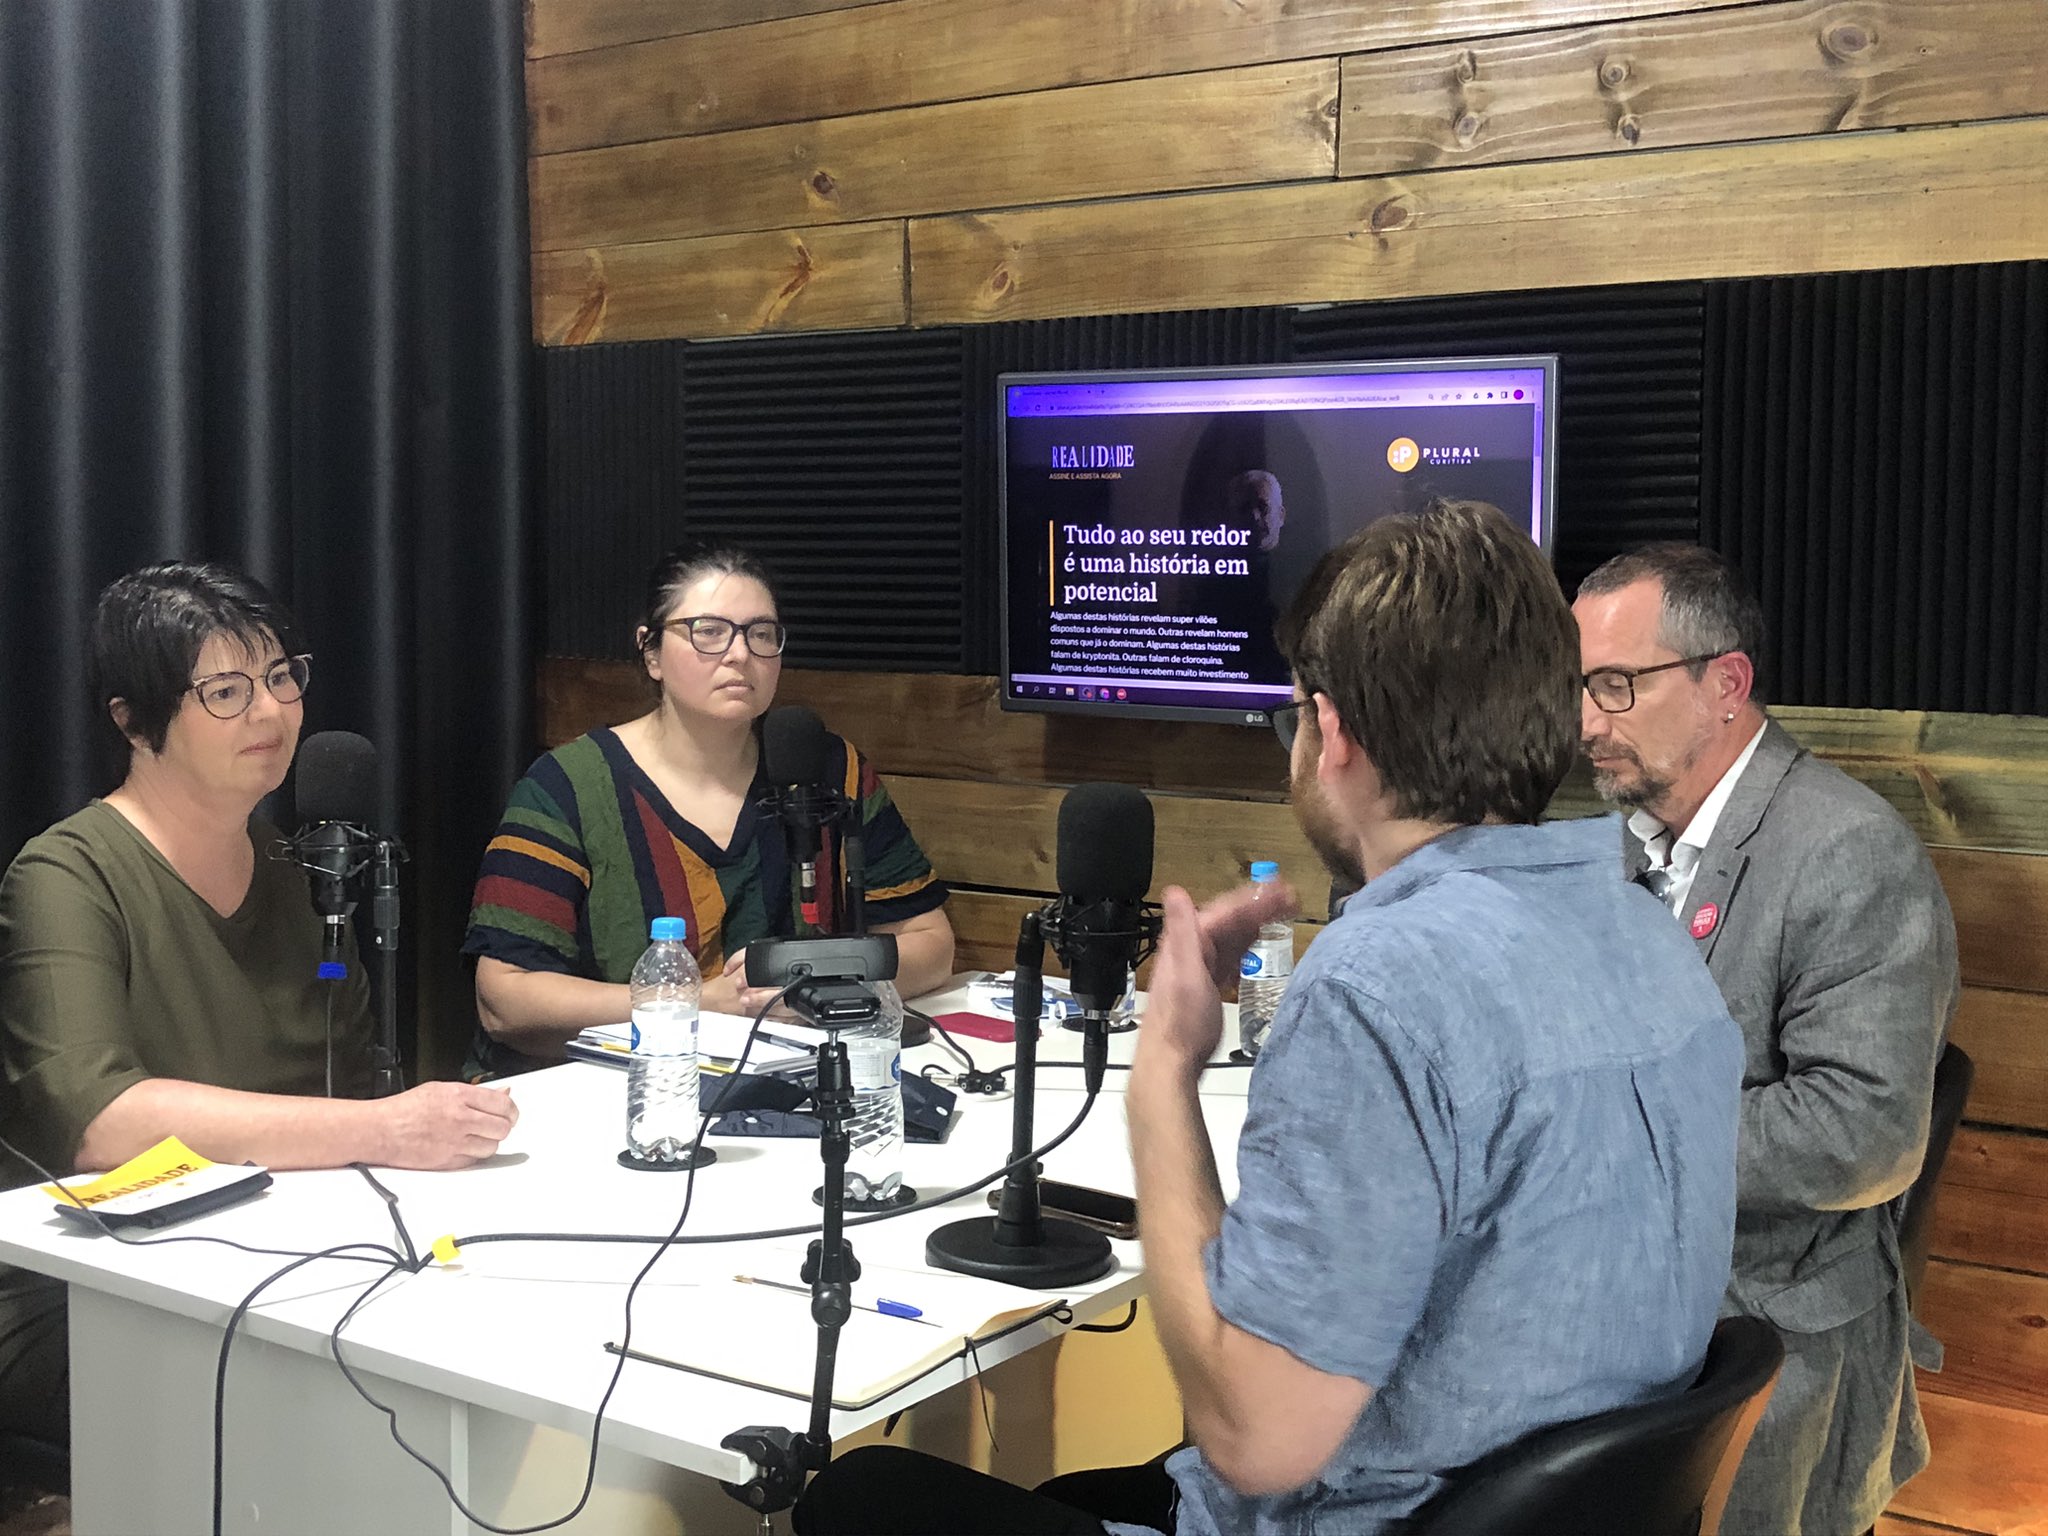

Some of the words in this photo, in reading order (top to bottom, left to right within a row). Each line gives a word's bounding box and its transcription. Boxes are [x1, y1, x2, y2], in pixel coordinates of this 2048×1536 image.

[1052, 445, 1135, 468] REALIDADE
[1423, 447, 1480, 458] PLURAL
[1049, 472, 1070, 480] ASSINE
[1076, 472, 1099, 480] ASSISTA
[1101, 472, 1122, 480] AGORA
[1063, 524, 1116, 545] Tudo
[1120, 528, 1144, 545] ao
[1149, 529, 1186, 545] seu
[1191, 524, 1251, 546] redor
[1063, 552, 1075, 572] é
[1080, 557, 1125, 573] uma
[1129, 552, 1210, 575] história
[1214, 559, 1249, 576] em
[1064, 581, 1158, 604] potencial
[1050, 611, 1082, 621] Algumas
[1082, 612, 1107, 621] destas
[1108, 613, 1140, 622] histórias
[1141, 614, 1171, 623] revelam
[1172, 616, 1194, 625] super
[1195, 615, 1218, 624] vilões
[1050, 624, 1085, 634] dispostos
[1092, 626, 1122, 634] dominar
[1129, 627, 1157, 636] mundo.
[1158, 627, 1184, 637] Outras
[1185, 629, 1216, 638] revelam
[1216, 629, 1249, 639] homens
[1050, 638, 1079, 646] comuns
[1094, 638, 1101, 648] já
[1109, 639, 1145, 648] dominam.
[1146, 640, 1179, 650] Algumas
[1180, 642, 1206, 651] destas
[1207, 642, 1241, 652] histórias
[1051, 650, 1071, 659] falam
[1071, 651, 1081, 659] de
[1082, 651, 1121, 661] kryptonita.
[1122, 652, 1148, 661] Outras
[1148, 654, 1170, 663] falam
[1170, 654, 1180, 664] de
[1182, 655, 1224, 666] cloroquina.
[1051, 663, 1082, 673] Algumas
[1083, 664, 1107, 673] destas
[1108, 665, 1140, 675] histórias
[1141, 668, 1174, 676] recebem
[1175, 668, 1198, 677] muito
[1198, 669, 1249, 680] investimento
[1254, 714, 1264, 722] LG
